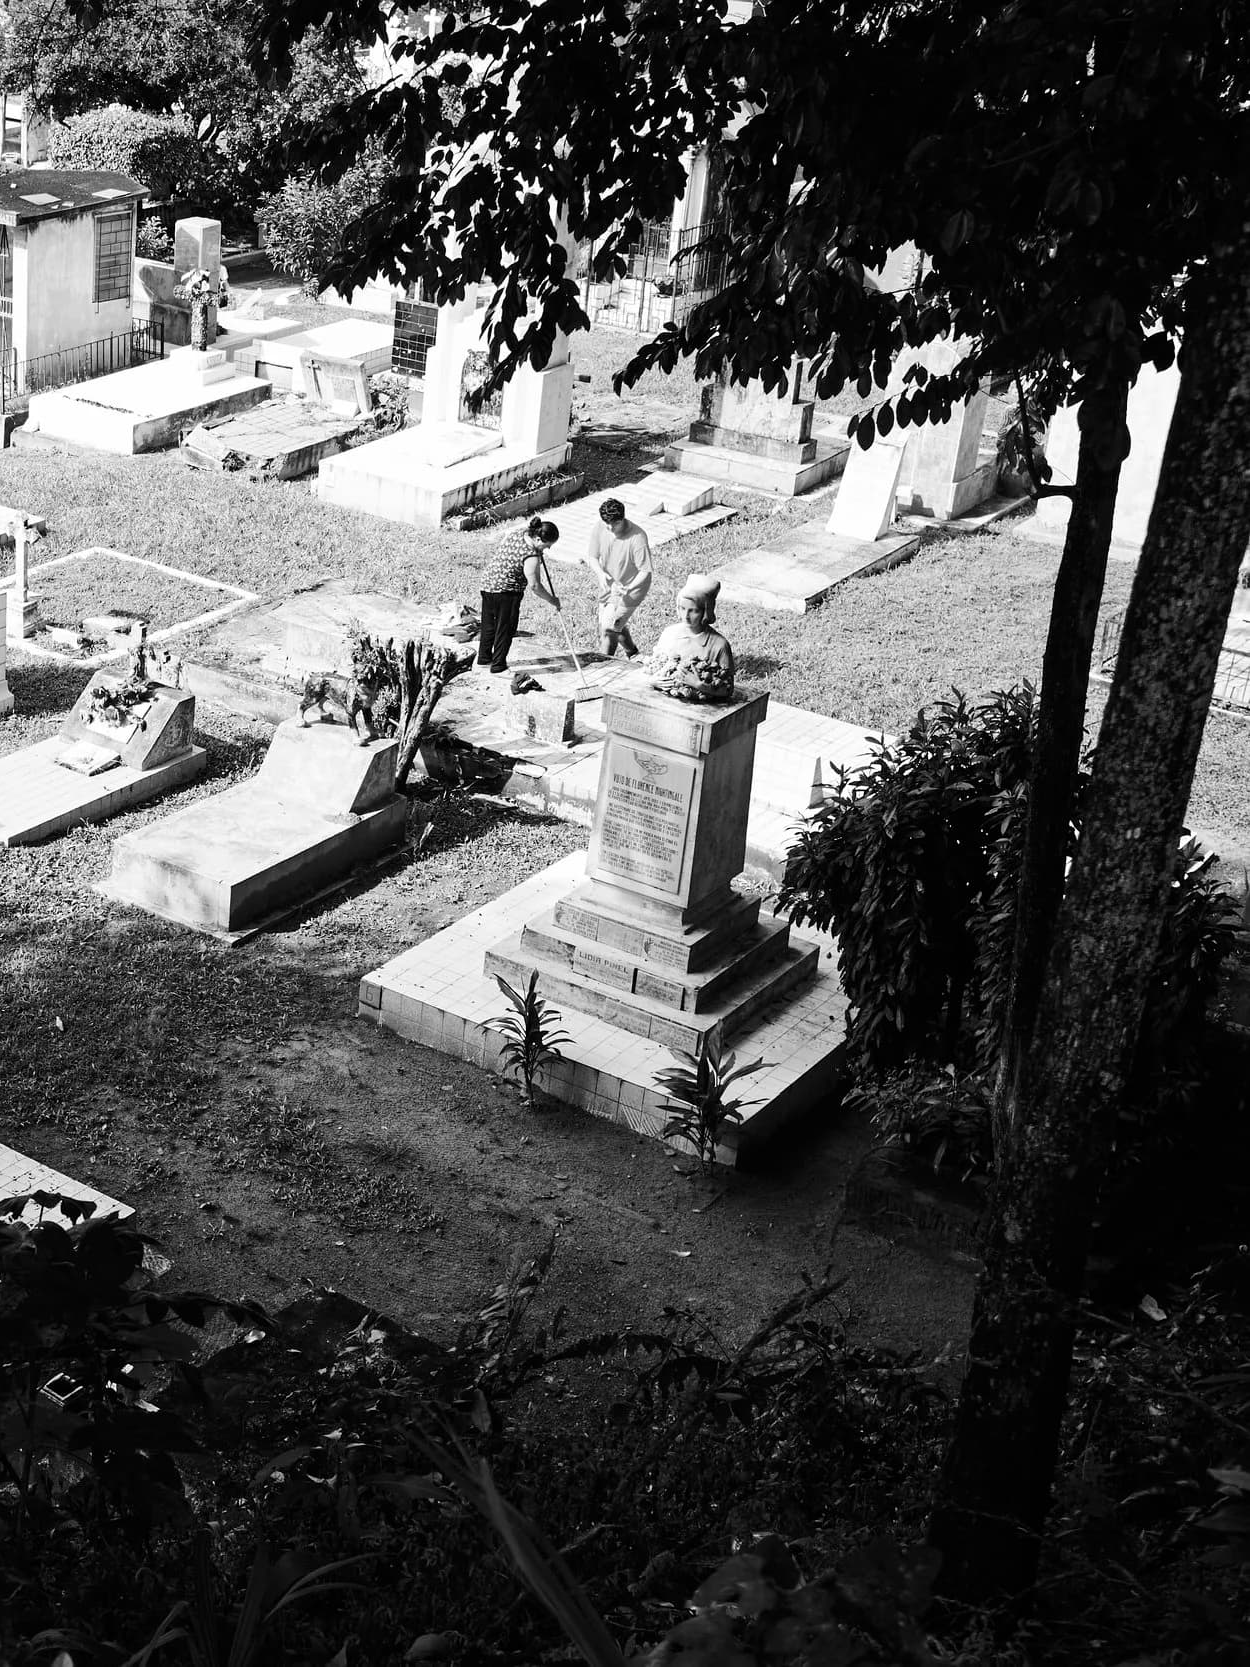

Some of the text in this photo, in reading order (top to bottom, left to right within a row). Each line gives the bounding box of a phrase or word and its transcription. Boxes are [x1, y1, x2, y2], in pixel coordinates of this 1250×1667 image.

[632, 779, 654, 794] FLORENCE
[579, 951, 601, 965] LIDIA
[366, 984, 374, 1002] 6
